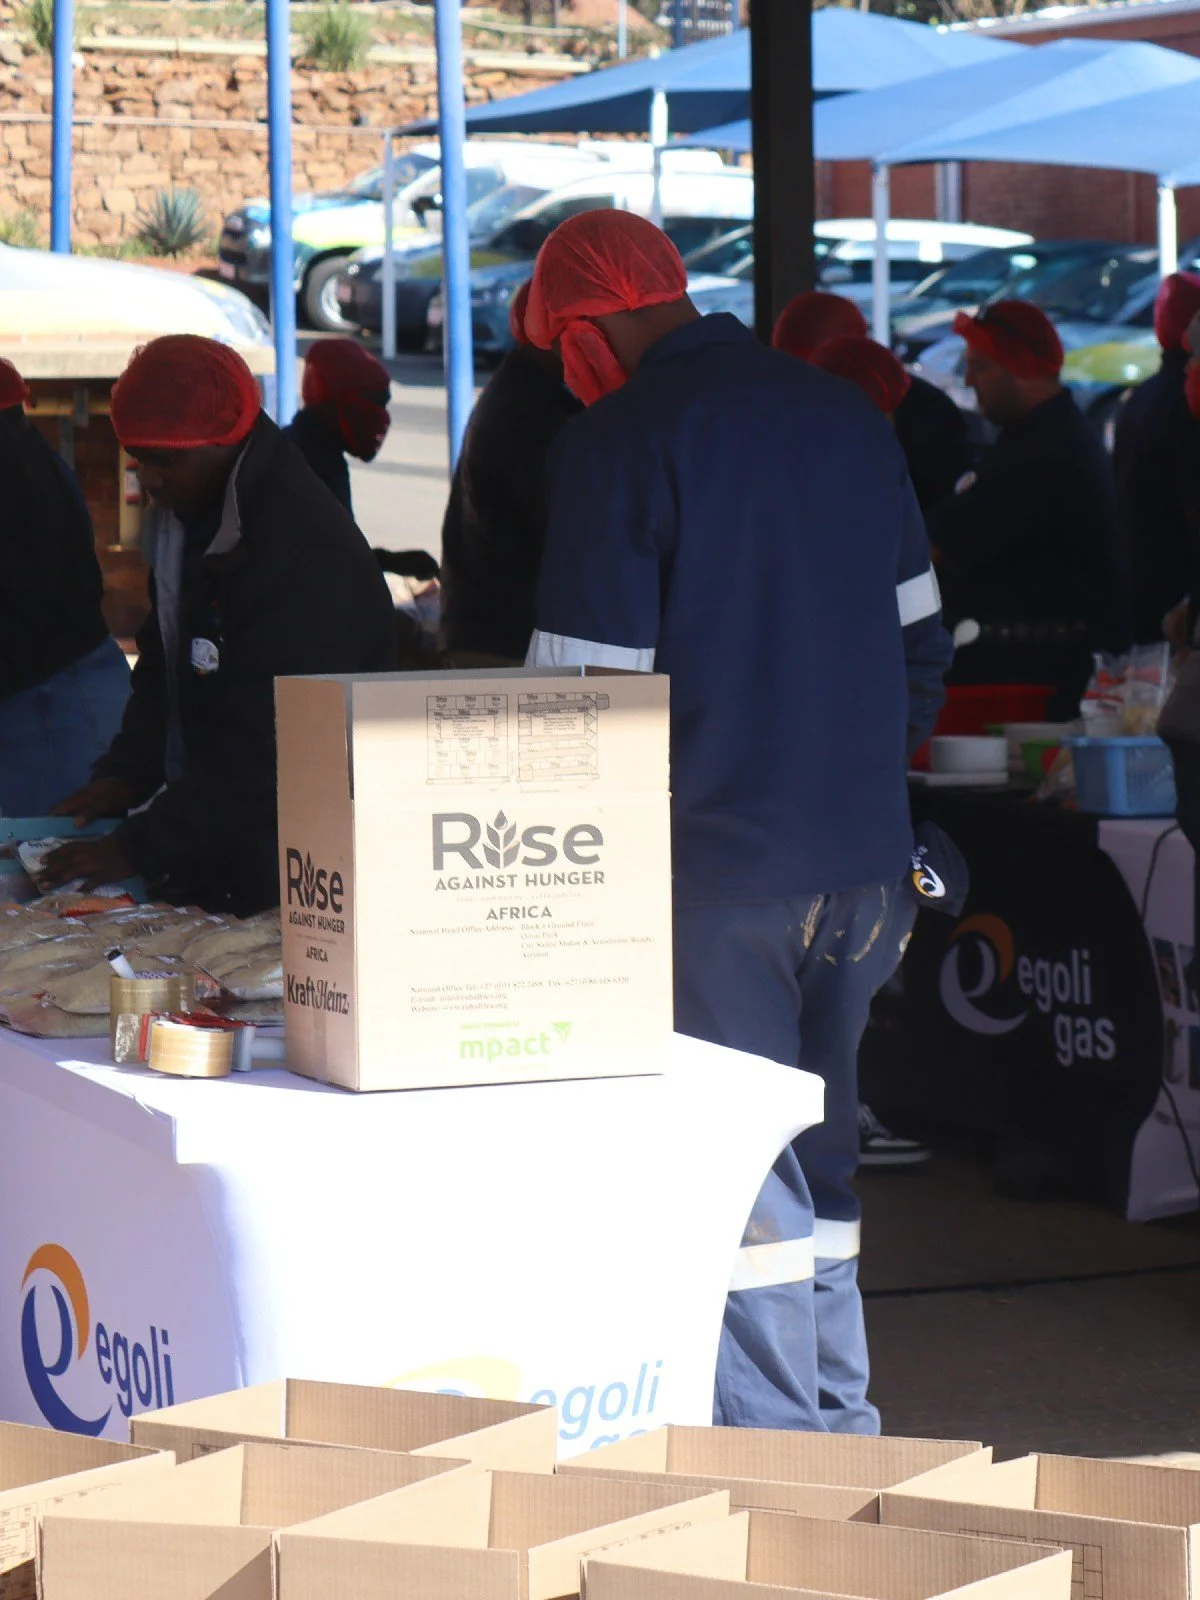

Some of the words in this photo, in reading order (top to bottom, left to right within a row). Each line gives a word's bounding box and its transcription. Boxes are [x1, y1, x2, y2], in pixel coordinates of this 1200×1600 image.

[431, 809, 605, 871] Rise
[435, 874, 518, 892] AGAINST
[525, 871, 606, 888] HUNGER
[289, 911, 317, 929] AGAINST
[317, 915, 345, 934] HUNGER
[486, 905, 553, 921] AFRICA
[462, 923, 483, 933] Office
[548, 920, 575, 930] Ground
[576, 919, 595, 928] Floor
[306, 945, 328, 963] AFRICA
[409, 984, 441, 994] National
[442, 983, 463, 993] Office
[1017, 948, 1092, 1013] egoli
[459, 1032, 552, 1063] mpact
[1054, 1012, 1117, 1068] gas
[95, 1321, 175, 1418] egoli
